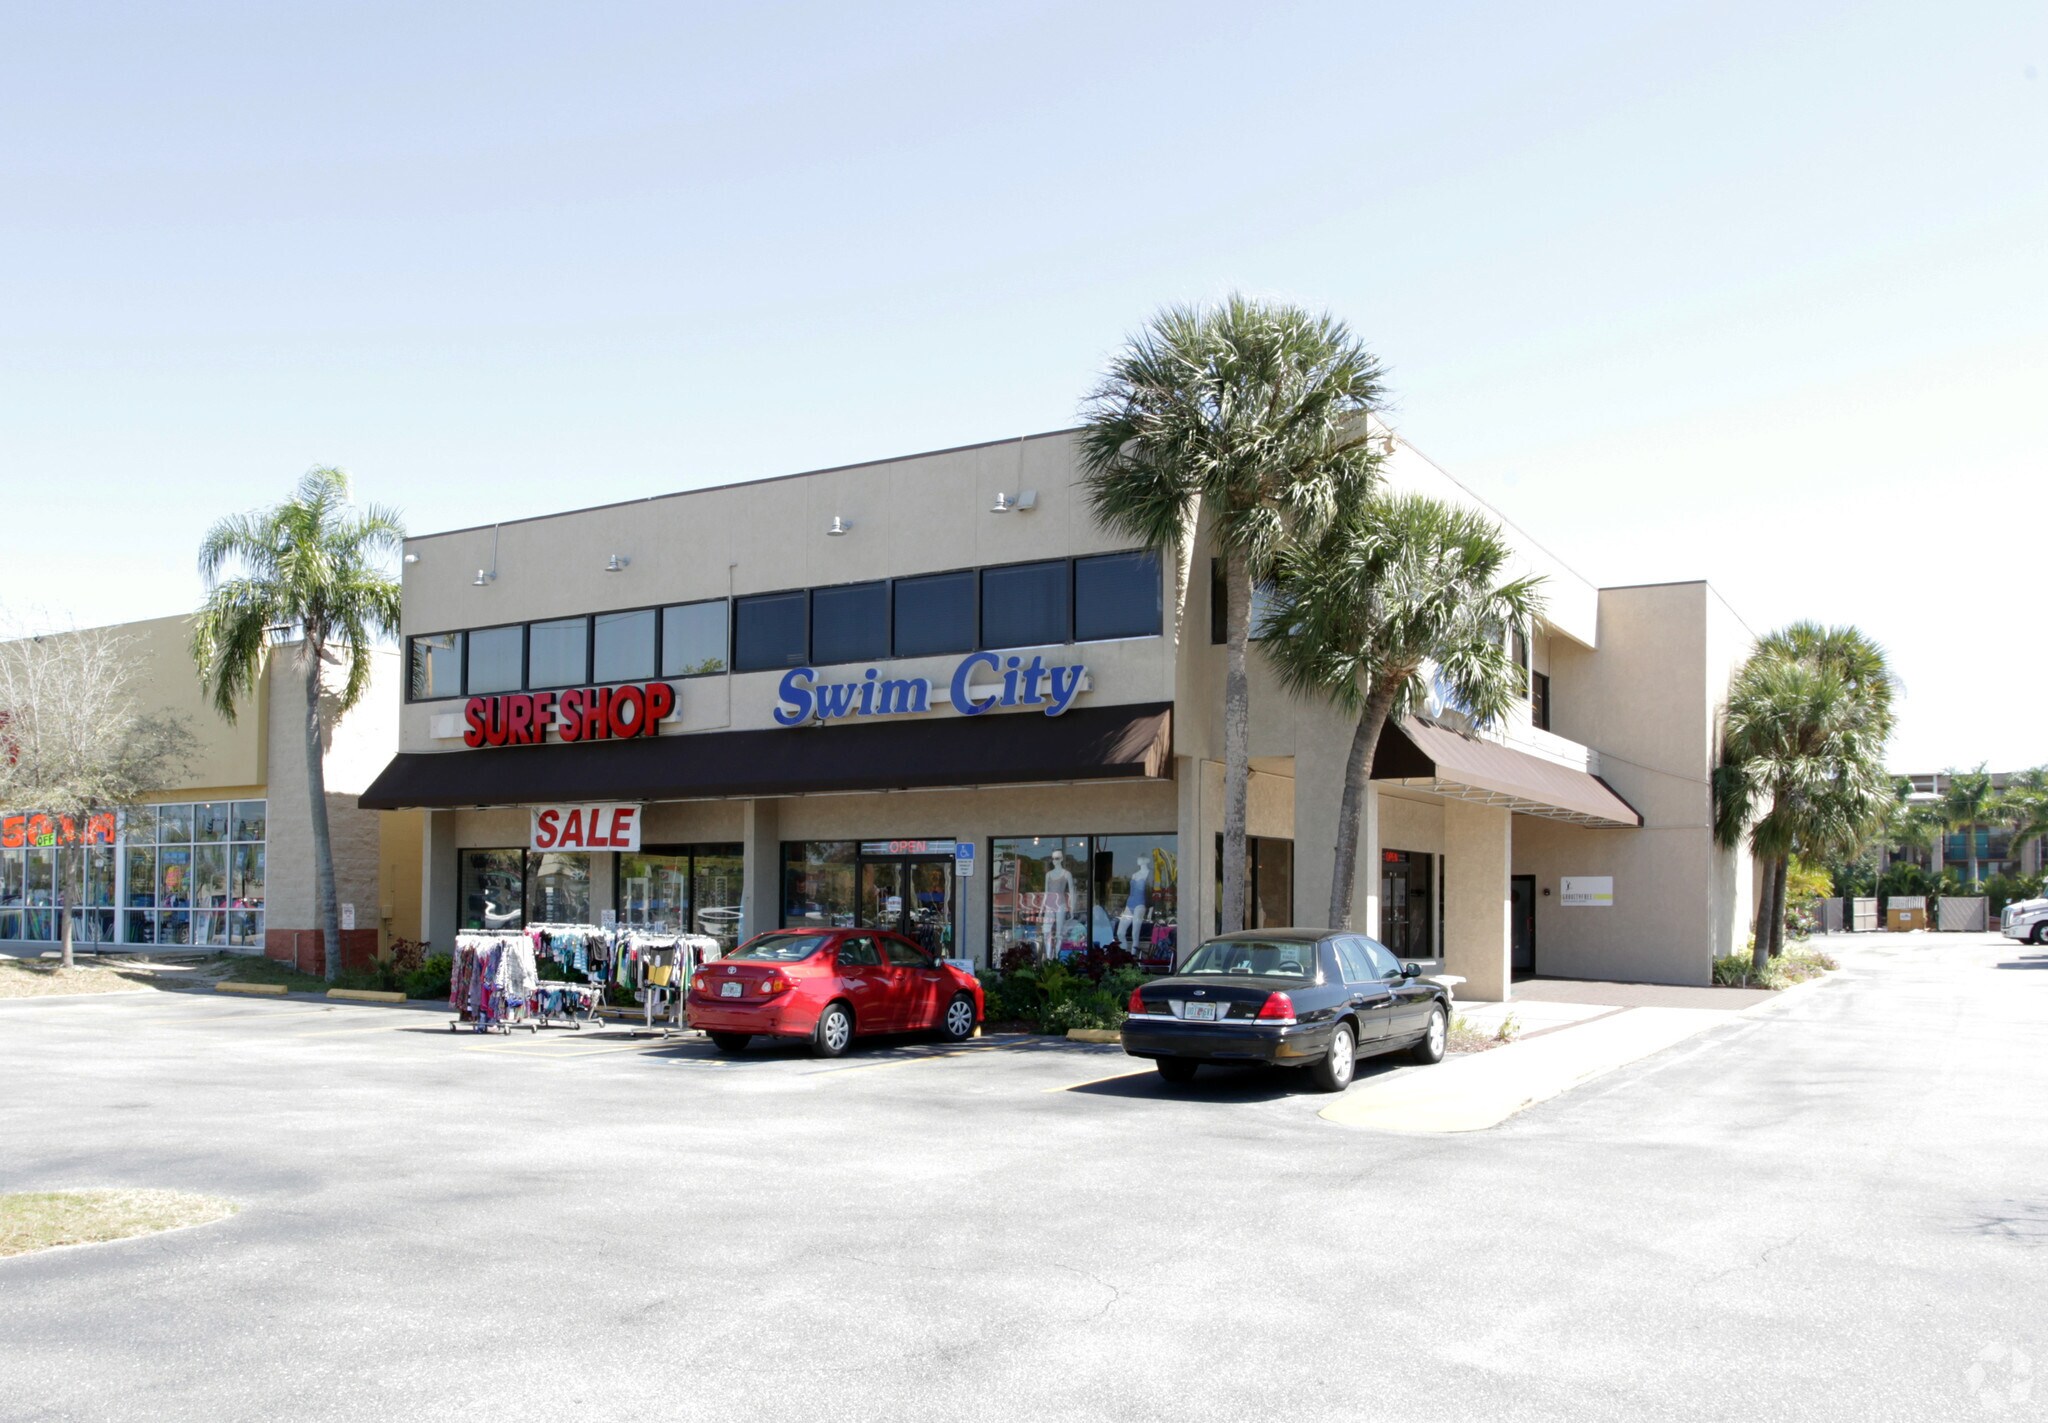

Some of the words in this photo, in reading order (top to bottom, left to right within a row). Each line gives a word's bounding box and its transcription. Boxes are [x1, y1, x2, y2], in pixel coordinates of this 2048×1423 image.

[773, 667, 931, 726] Swim
[950, 652, 1087, 717] City
[464, 692, 556, 748] SURF
[559, 683, 675, 742] SHOP
[37, 834, 54, 846] OFF
[536, 808, 636, 849] SALE
[888, 841, 927, 853] OPEN
